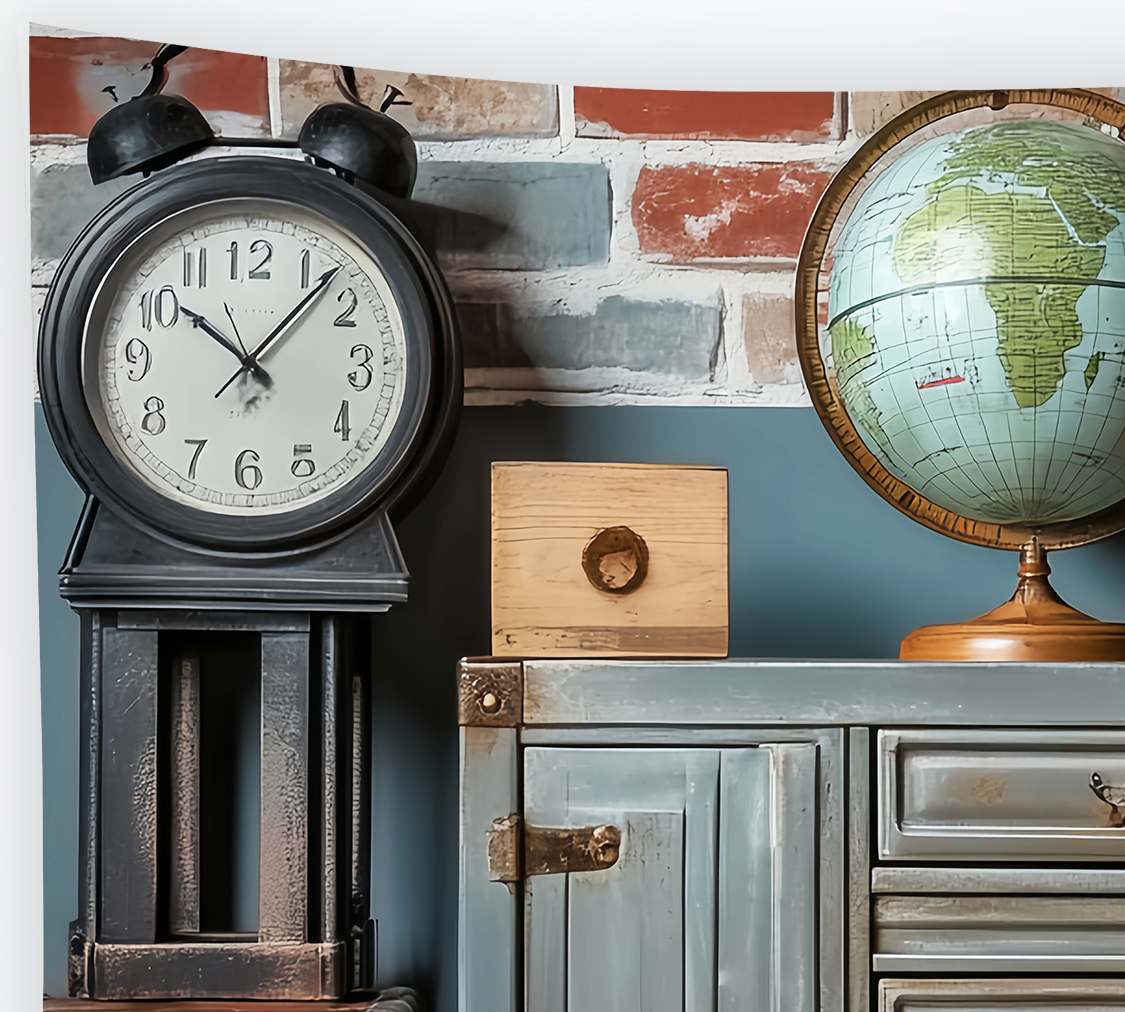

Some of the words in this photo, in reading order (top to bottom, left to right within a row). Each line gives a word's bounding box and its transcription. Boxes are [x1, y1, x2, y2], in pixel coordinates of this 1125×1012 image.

[183, 246, 207, 288] 11
[226, 240, 273, 280] 12
[301, 248, 311, 289] 1
[140, 285, 179, 331] 10
[333, 288, 357, 327] 2
[125, 338, 151, 381] 9
[347, 344, 374, 391] 3
[141, 396, 166, 435] 8
[333, 400, 352, 441] 4
[184, 439, 208, 479] 7
[235, 450, 263, 490] 6
